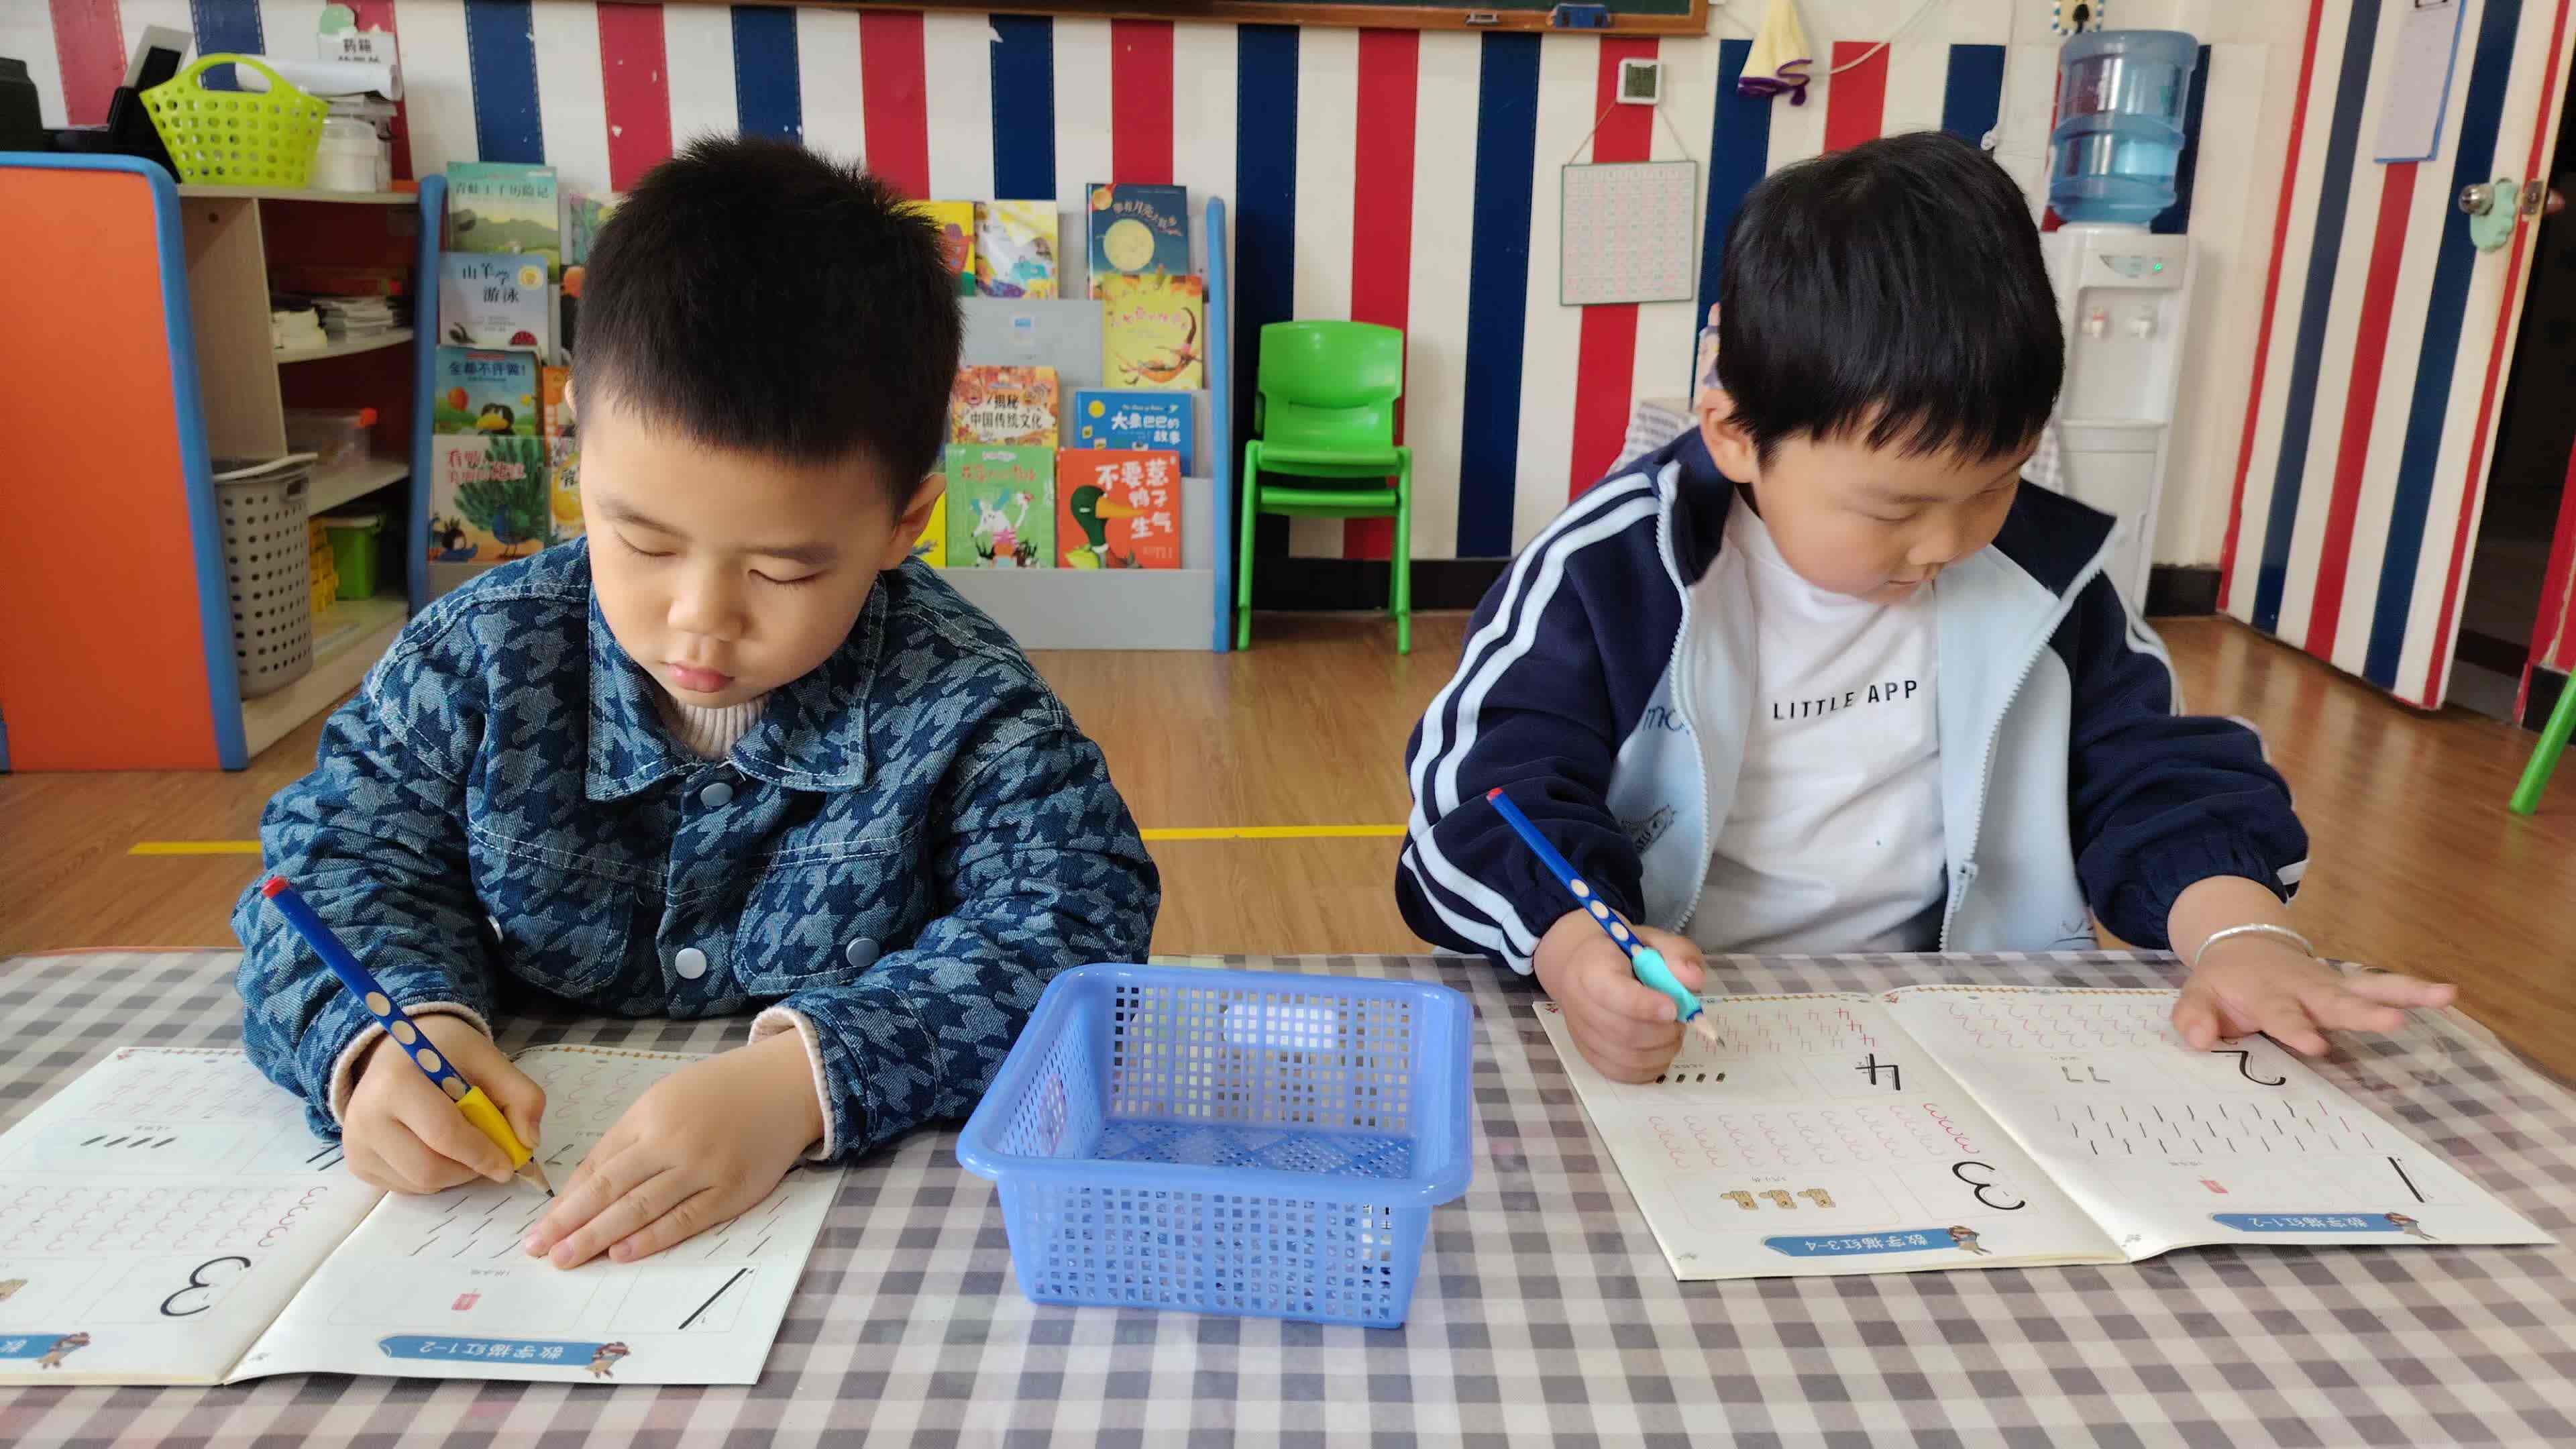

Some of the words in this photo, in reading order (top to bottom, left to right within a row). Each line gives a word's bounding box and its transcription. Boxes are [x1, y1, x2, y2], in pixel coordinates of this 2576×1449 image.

[462, 262, 510, 285] 山羊学
[483, 286, 519, 303] 游泳
[994, 394, 1019, 409] 揭秘
[971, 411, 1042, 430] 中国传统文化
[1110, 411, 1180, 430] 大象巴巴的
[1153, 429, 1181, 445] 故事
[1095, 458, 1169, 491] 不要惹
[1128, 488, 1168, 508] 鸭子
[1130, 511, 1173, 539] 生气
[1773, 691, 1856, 720] LITTLE
[1868, 680, 1918, 703] APP
[1854, 1053, 1901, 1091] 4
[2210, 1050, 2286, 1087] 2
[1951, 1161, 2026, 1211] 3
[2387, 1156, 2424, 1203] 1
[2247, 1216, 2368, 1230] 数字描红1-2
[1804, 1233, 1928, 1252] 数字描红3-4
[160, 1256, 251, 1316] 3
[678, 1268, 749, 1330] 1
[419, 1341, 564, 1360] 数字描红1-2
